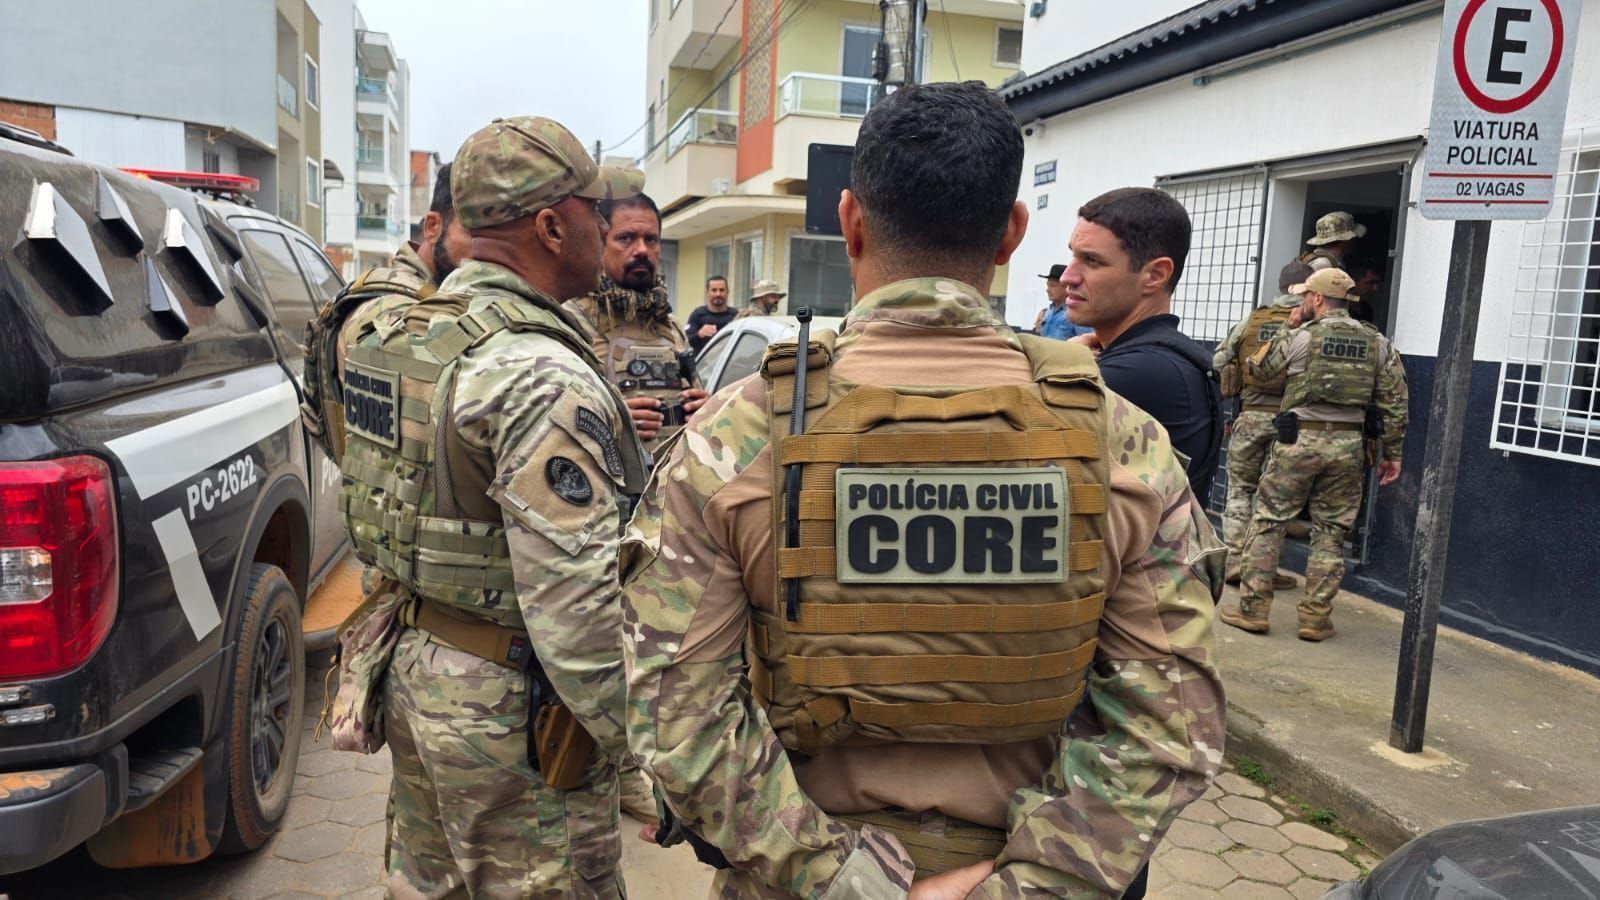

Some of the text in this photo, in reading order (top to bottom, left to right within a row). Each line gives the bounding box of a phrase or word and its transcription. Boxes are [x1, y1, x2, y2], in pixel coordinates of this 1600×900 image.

[1486, 7, 1532, 85] E
[1453, 120, 1539, 141] VIATURA
[1447, 146, 1538, 166] POLICIAL
[1456, 182, 1525, 196] 02 VAGAS
[1260, 330, 1276, 341] CO
[1323, 343, 1367, 358] CORE
[345, 388, 394, 441] CORE
[186, 454, 257, 521] PC-2622
[848, 478, 1058, 511] POLÍCIA CIVIL
[848, 514, 1058, 575] CORE
